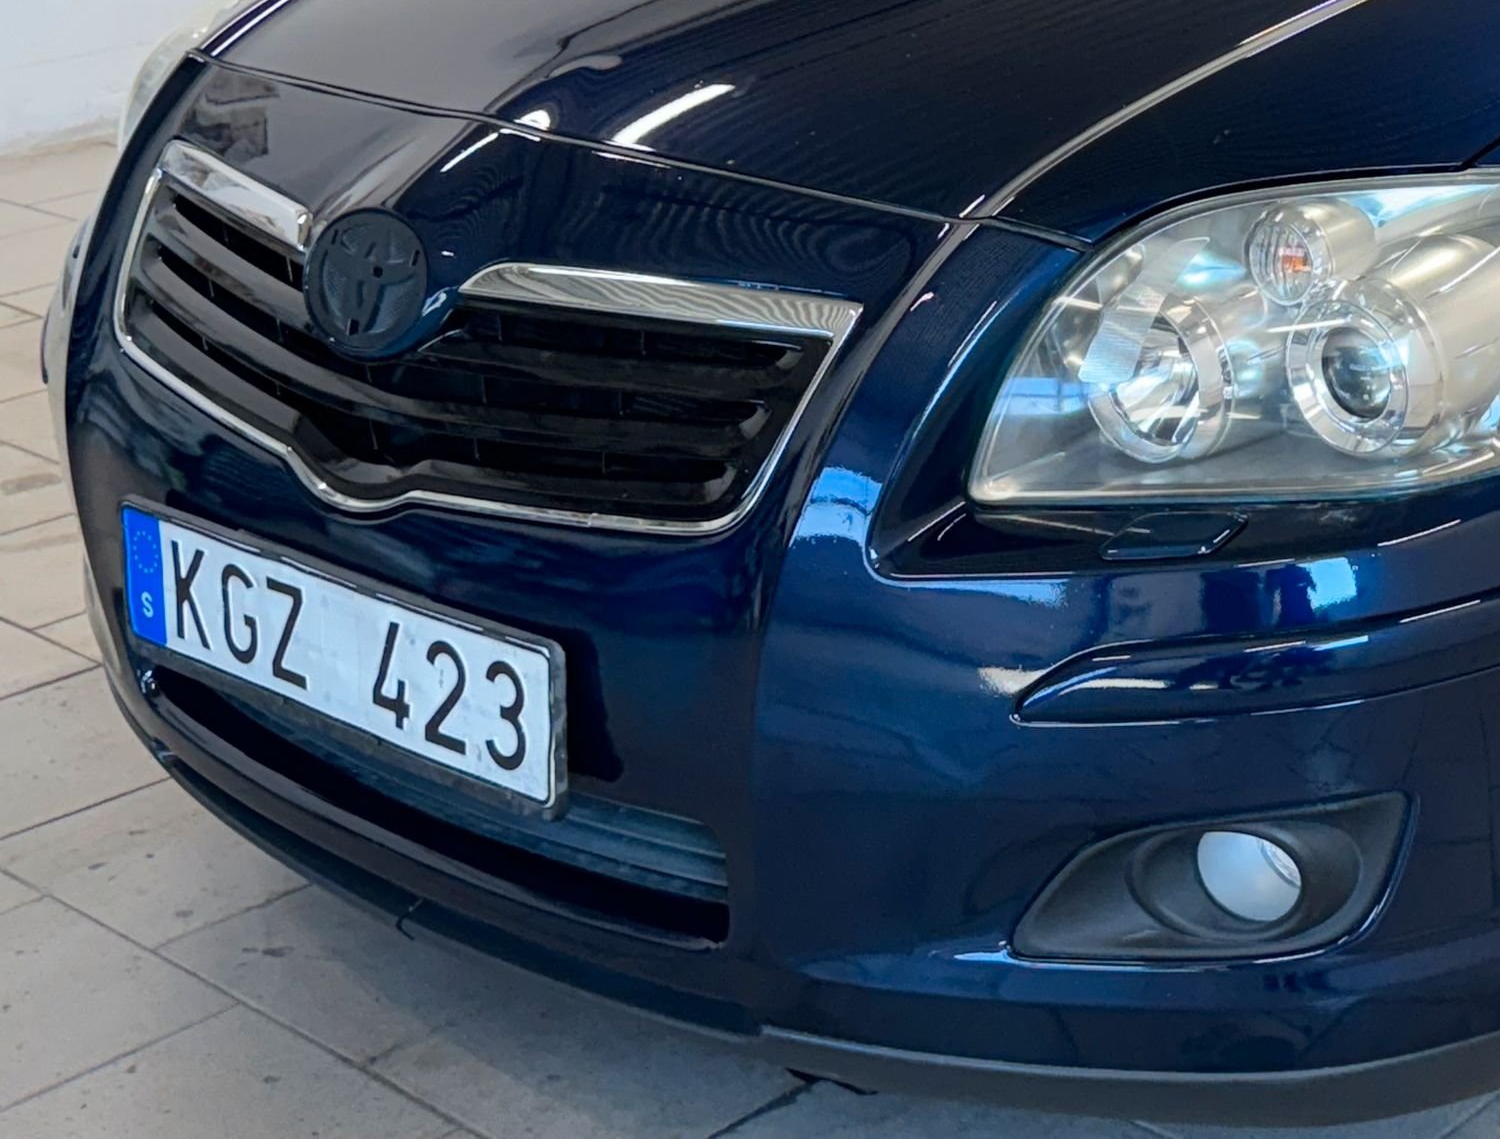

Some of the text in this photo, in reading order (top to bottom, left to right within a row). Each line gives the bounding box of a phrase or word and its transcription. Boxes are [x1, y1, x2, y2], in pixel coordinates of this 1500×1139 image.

[142, 591, 154, 619] S
[171, 539, 527, 771] KGZ 423
